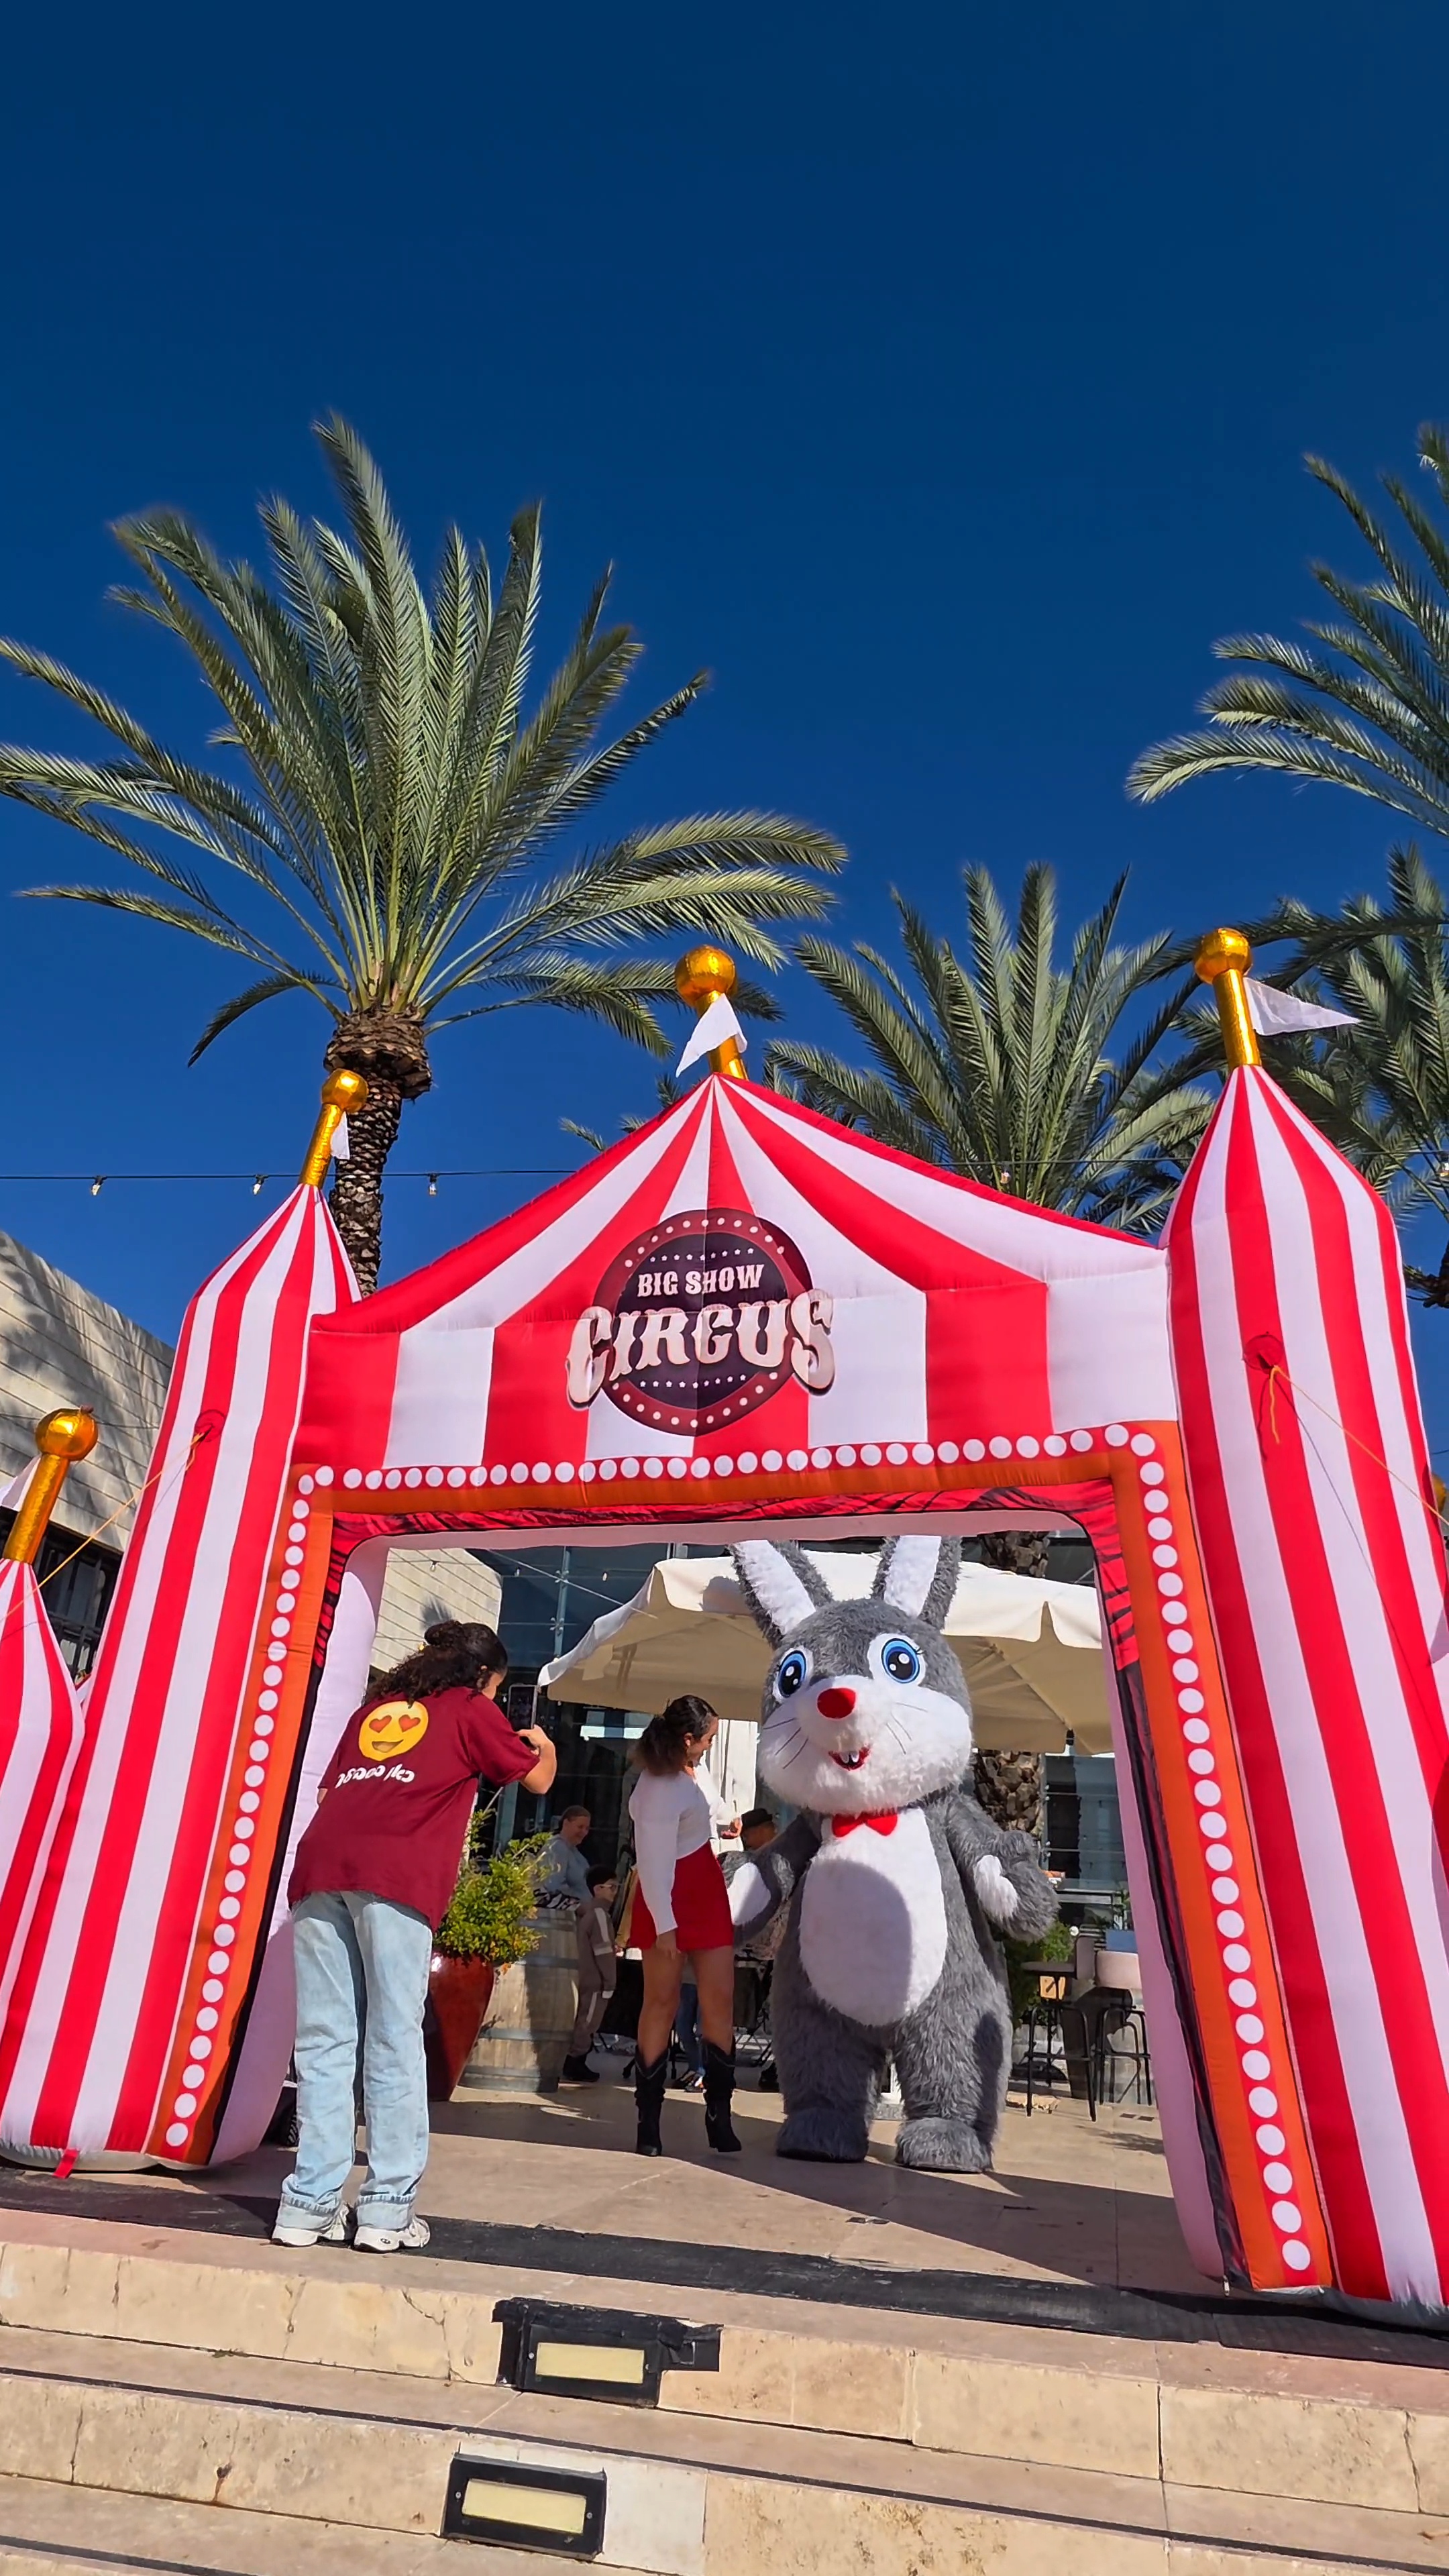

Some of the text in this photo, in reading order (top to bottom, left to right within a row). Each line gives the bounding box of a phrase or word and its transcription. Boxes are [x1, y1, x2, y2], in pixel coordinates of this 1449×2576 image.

[637, 1264, 764, 1297] BIG SHOW
[567, 1288, 835, 1405] CIRCUS
[383, 1764, 415, 1783] כאן
